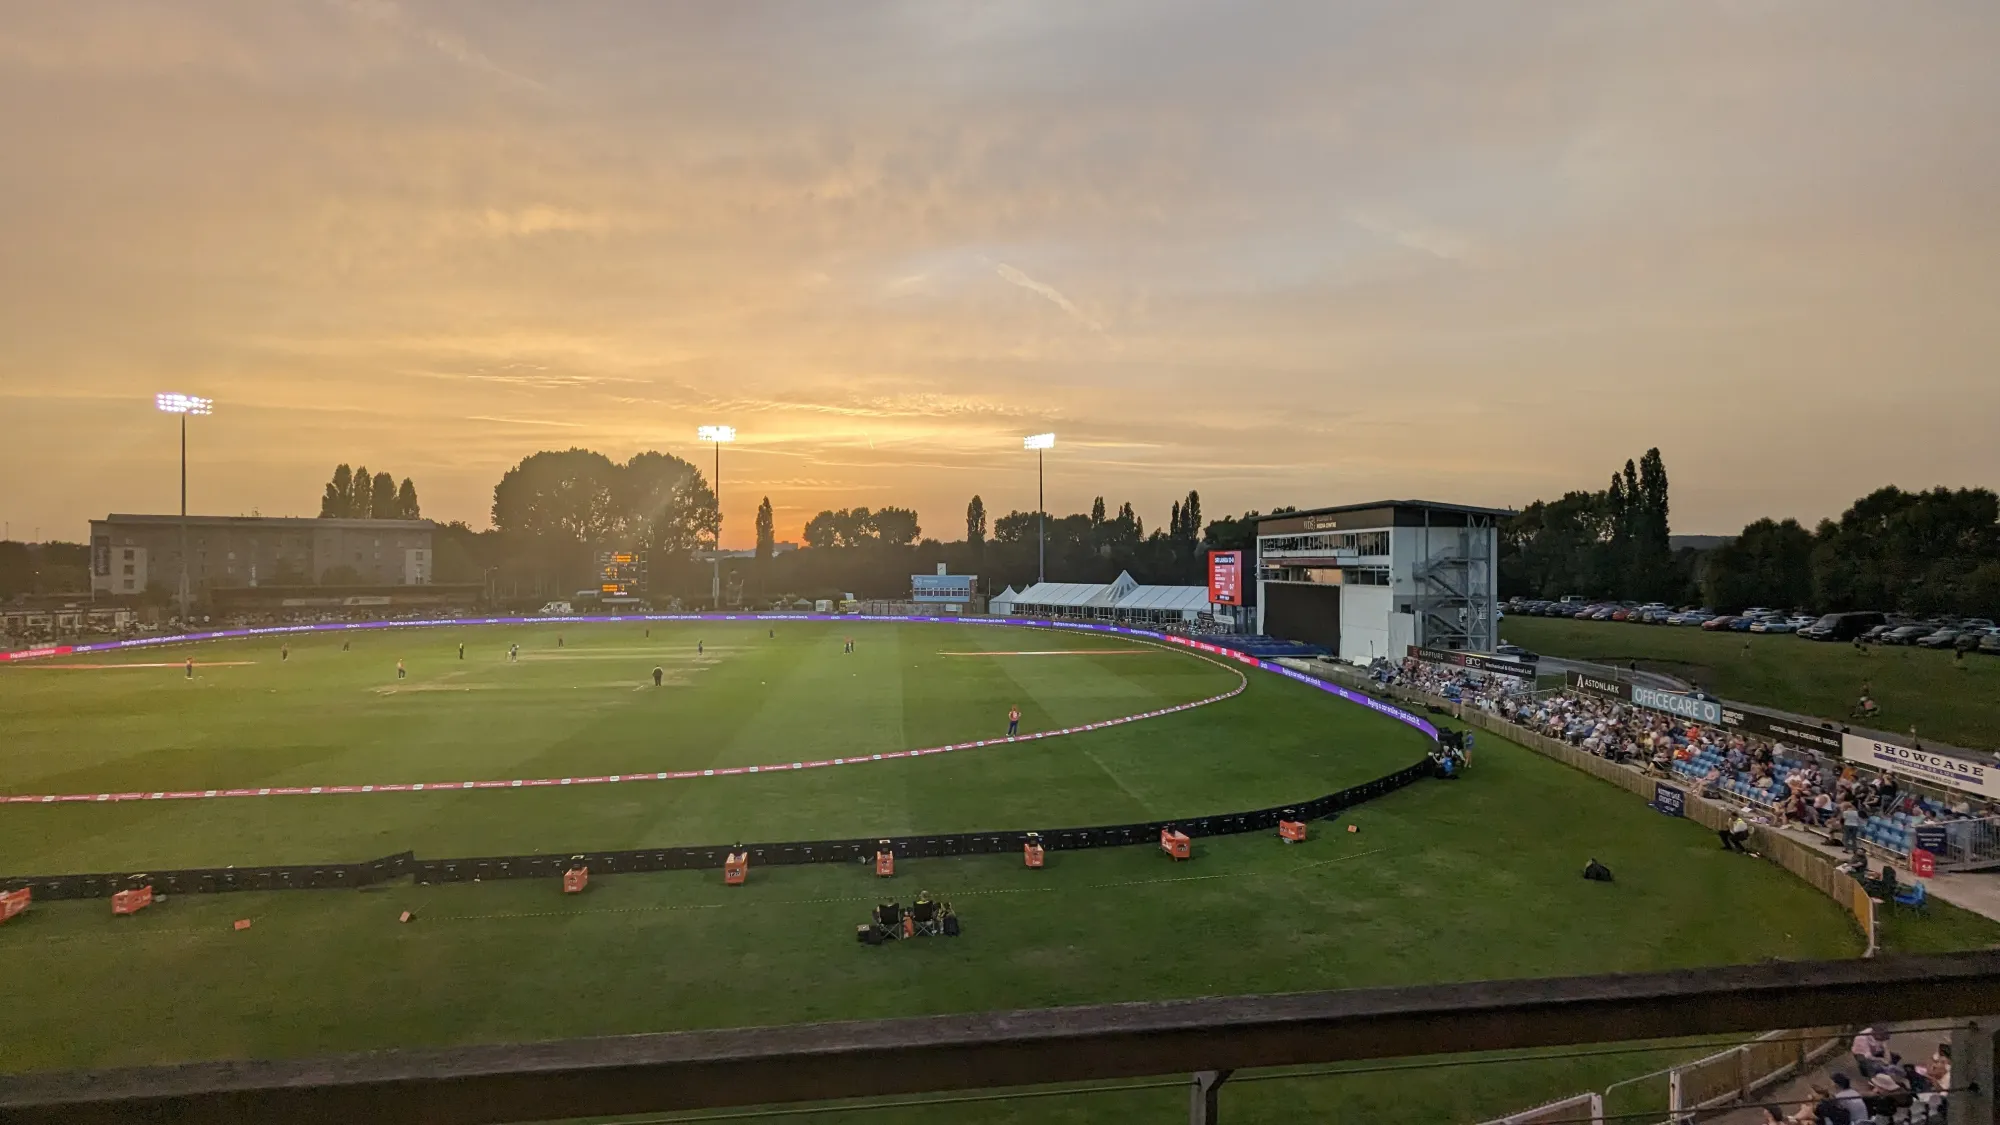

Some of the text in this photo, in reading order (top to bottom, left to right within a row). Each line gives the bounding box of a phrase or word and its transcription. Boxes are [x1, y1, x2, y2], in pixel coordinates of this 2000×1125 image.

[10, 651, 28, 659] Health
[1466, 656, 1481, 666] arc
[1585, 680, 1619, 694] ASTONLARK
[1635, 687, 1700, 717] OFFICECARE
[1874, 743, 1984, 777] SHOWCASE
